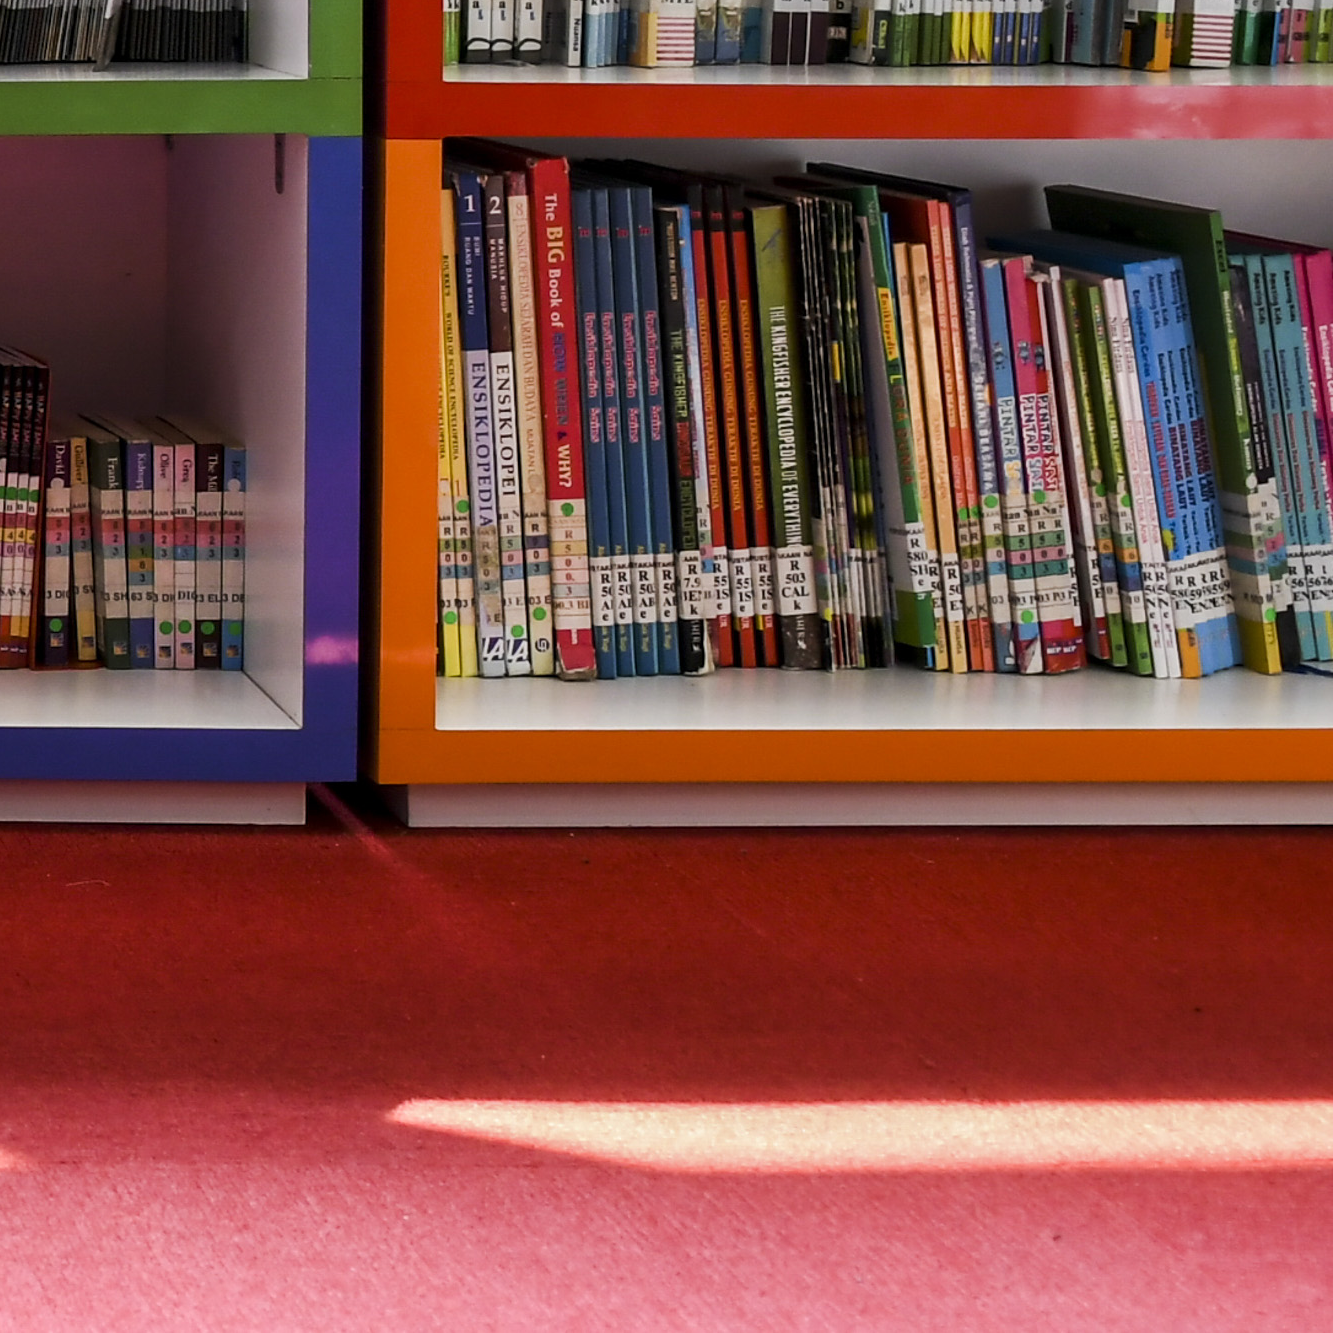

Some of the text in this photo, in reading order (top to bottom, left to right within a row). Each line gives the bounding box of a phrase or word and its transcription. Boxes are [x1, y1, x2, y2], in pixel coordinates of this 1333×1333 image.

[464, 195, 476, 212] 1
[489, 196, 502, 214] 2
[544, 194, 556, 221] The
[546, 226, 565, 263] BIG
[548, 268, 563, 308] Book
[550, 312, 565, 328] of
[769, 306, 786, 323] THE
[771, 325, 792, 388] KINGFISHER
[670, 329, 688, 419] THE KINGFISHER
[775, 390, 797, 470] ENCYCLOPEDIA
[998, 396, 1019, 458] PINTAR
[1020, 393, 1040, 455] PINTAR
[1036, 392, 1054, 453] PINTAR
[472, 362, 494, 526] ENSIKLOPEDIA
[55, 445, 66, 479] David
[557, 445, 573, 488] WHY?
[782, 471, 798, 483] OF
[790, 561, 800, 571] R
[908, 552, 927, 562] 580
[782, 587, 810, 598] CAL
[785, 573, 806, 584] 503
[793, 599, 802, 610] k
